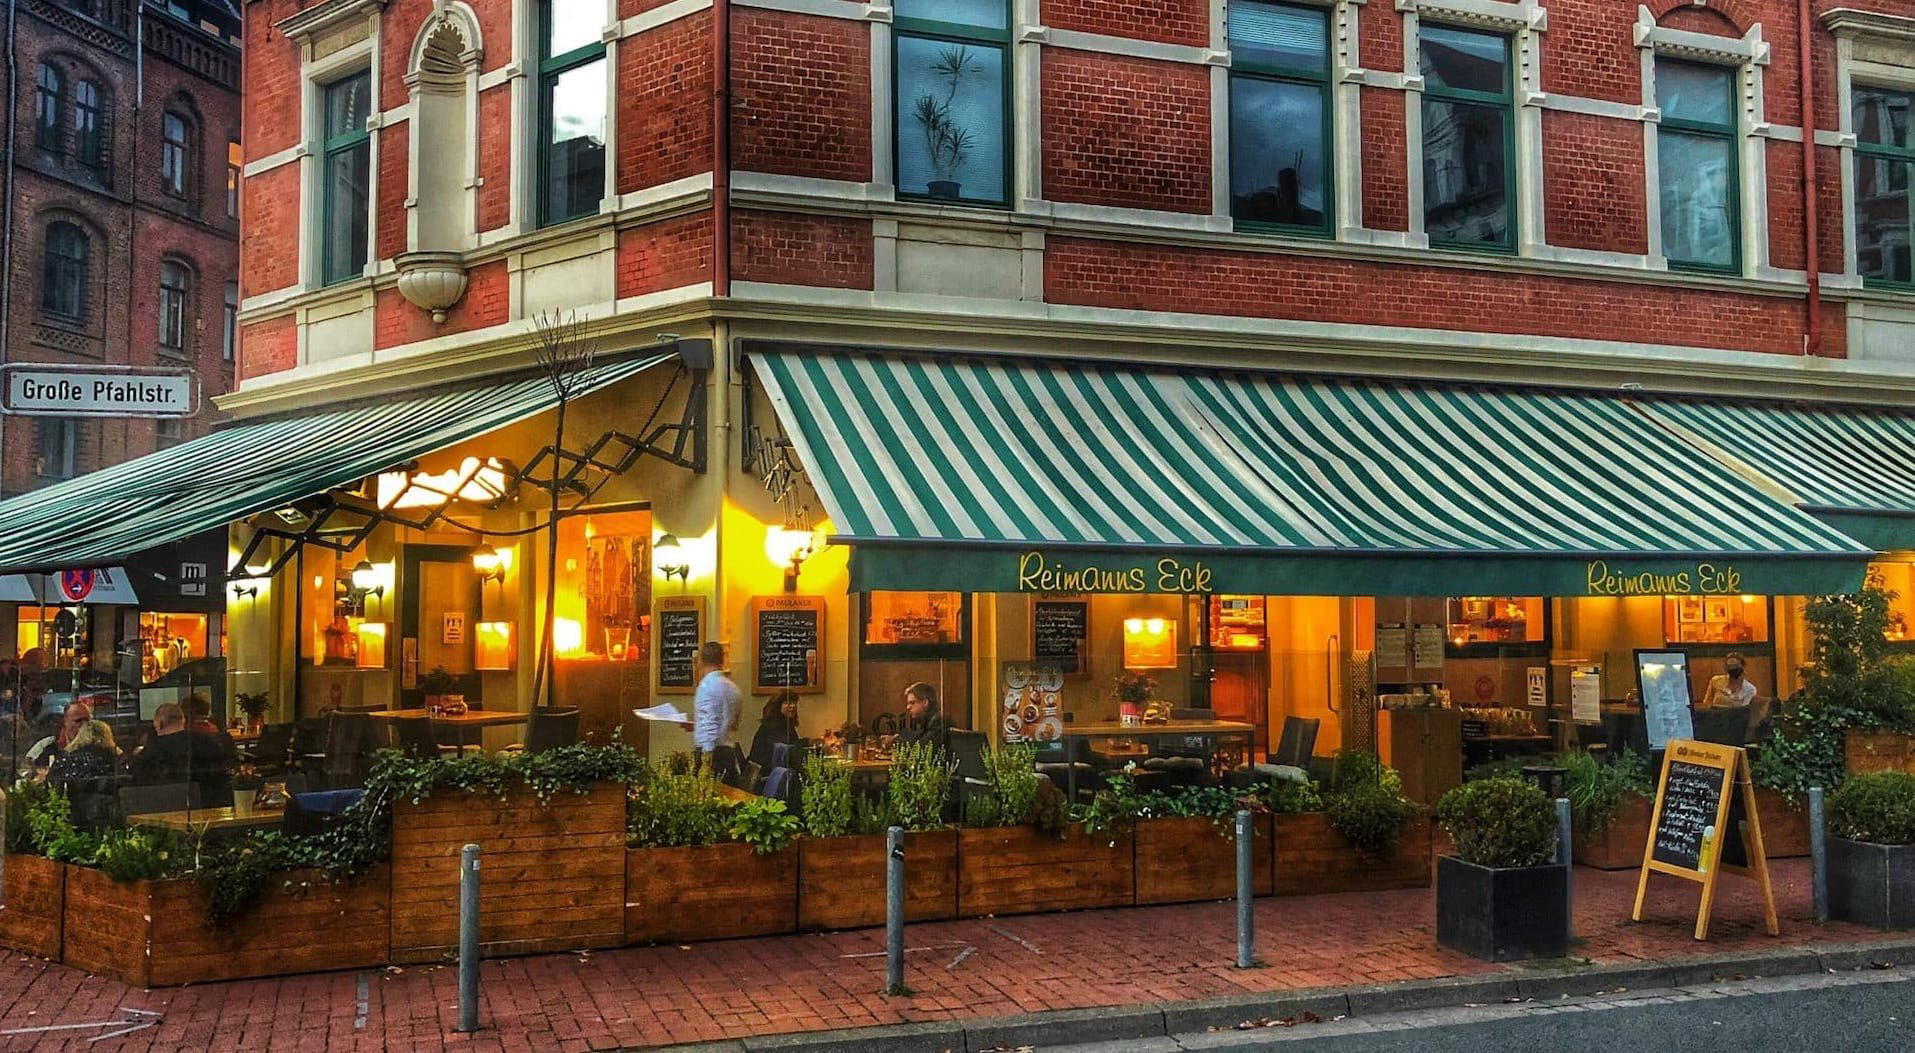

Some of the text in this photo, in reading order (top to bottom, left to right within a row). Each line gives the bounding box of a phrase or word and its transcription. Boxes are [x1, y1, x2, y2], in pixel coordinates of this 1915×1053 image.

[22, 378, 177, 403] Große Pfahlstr.
[1018, 551, 1213, 592] Reimanns Eck
[1586, 559, 1742, 595] Reimanns Eck
